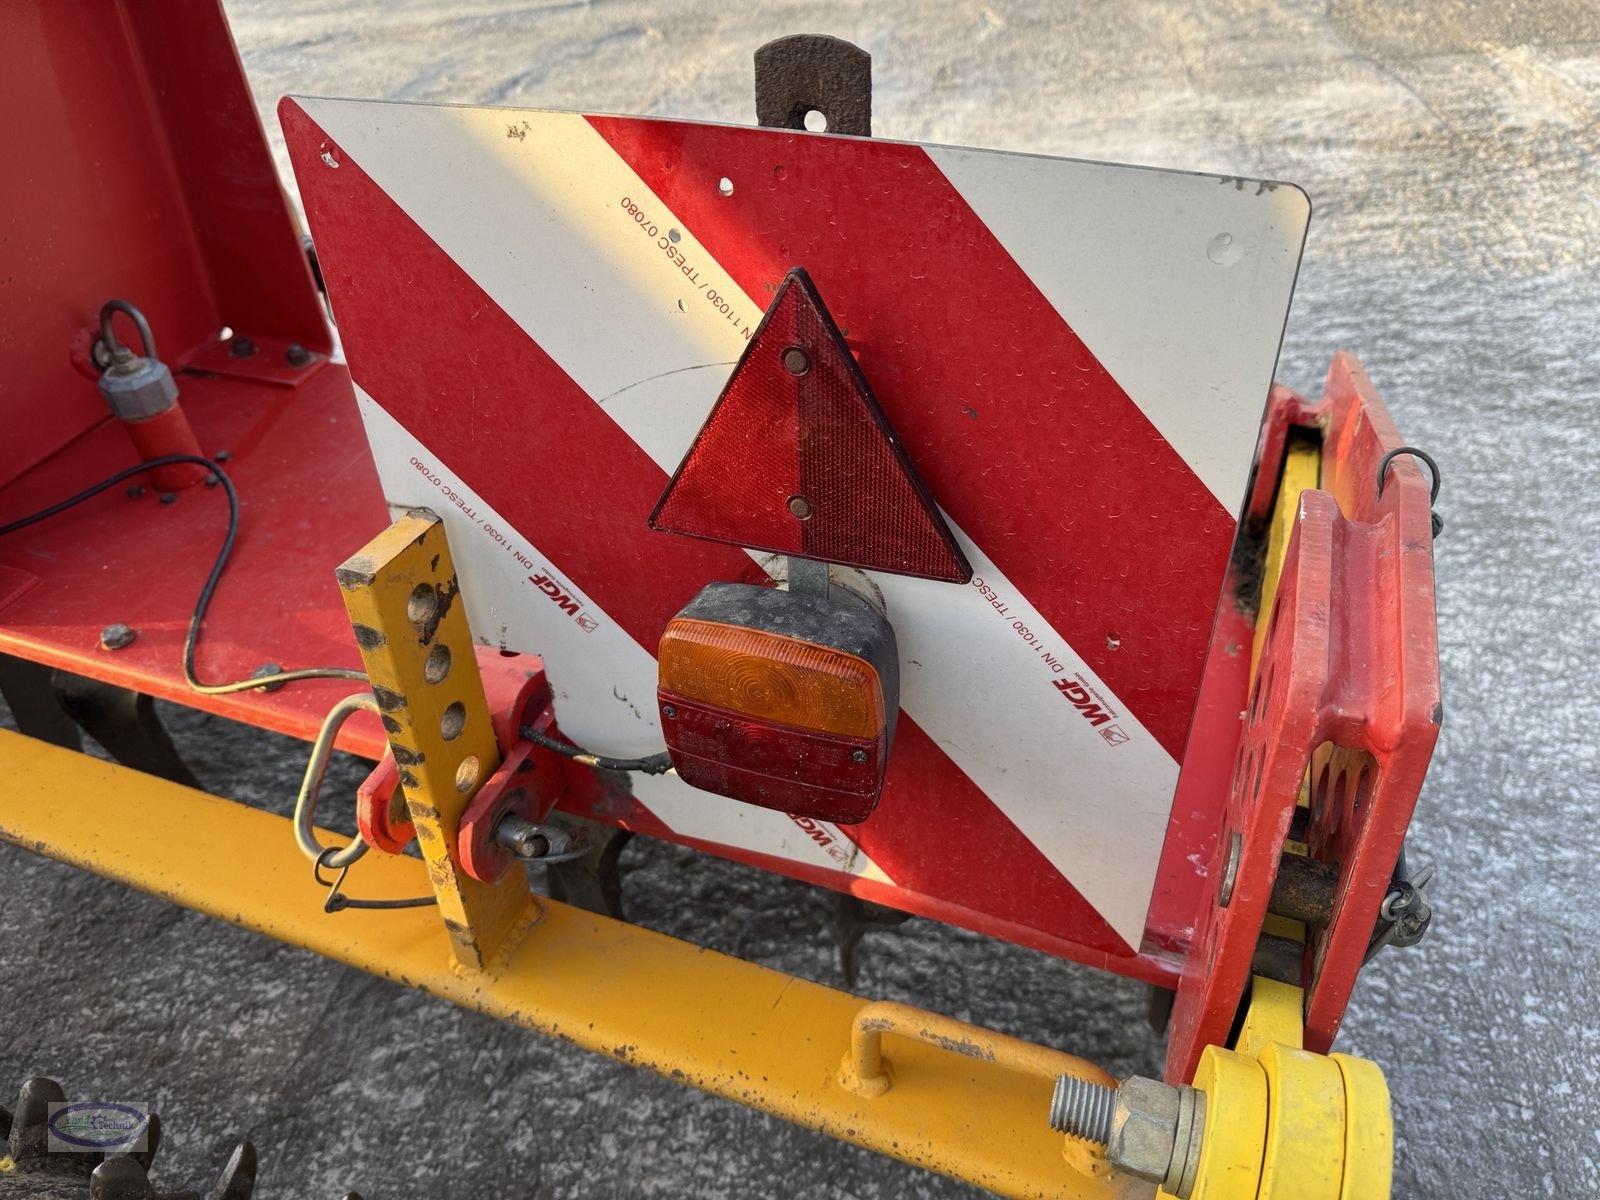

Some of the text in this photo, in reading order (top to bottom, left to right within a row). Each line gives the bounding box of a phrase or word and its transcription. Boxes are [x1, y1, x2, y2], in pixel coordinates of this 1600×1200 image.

[620, 197, 658, 237] 07080
[657, 236, 700, 285] TPESC
[706, 289, 743, 328] 11030
[409, 457, 442, 487] 07080
[441, 486, 477, 520] TPESC
[483, 524, 513, 552] 11030
[513, 551, 534, 570] DIN
[528, 573, 580, 617] WGF
[972, 577, 1009, 616] TPESC
[1012, 621, 1044, 652] 11030
[1041, 652, 1065, 673] DIN
[1051, 678, 1111, 727] WGF
